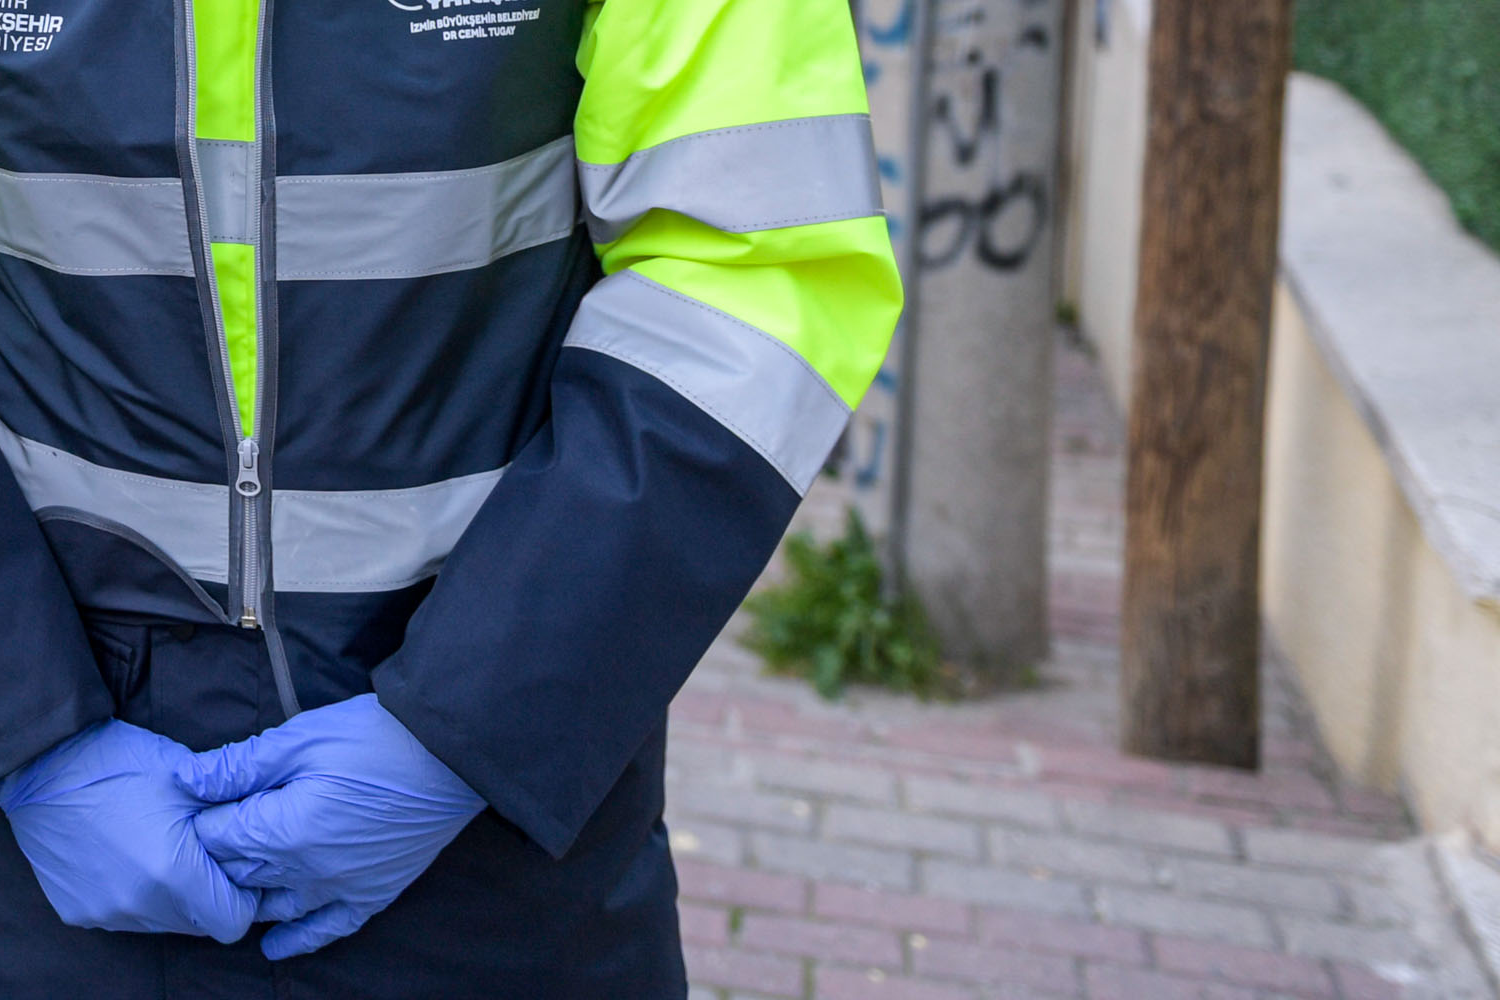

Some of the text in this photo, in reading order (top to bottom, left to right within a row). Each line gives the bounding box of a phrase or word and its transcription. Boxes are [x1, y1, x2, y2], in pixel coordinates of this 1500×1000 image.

[410, 19, 436, 34] İZMİR
[437, 11, 497, 29] BÜYÜKŞEHİR
[443, 25, 516, 41] DR CEMİL TUGAY
